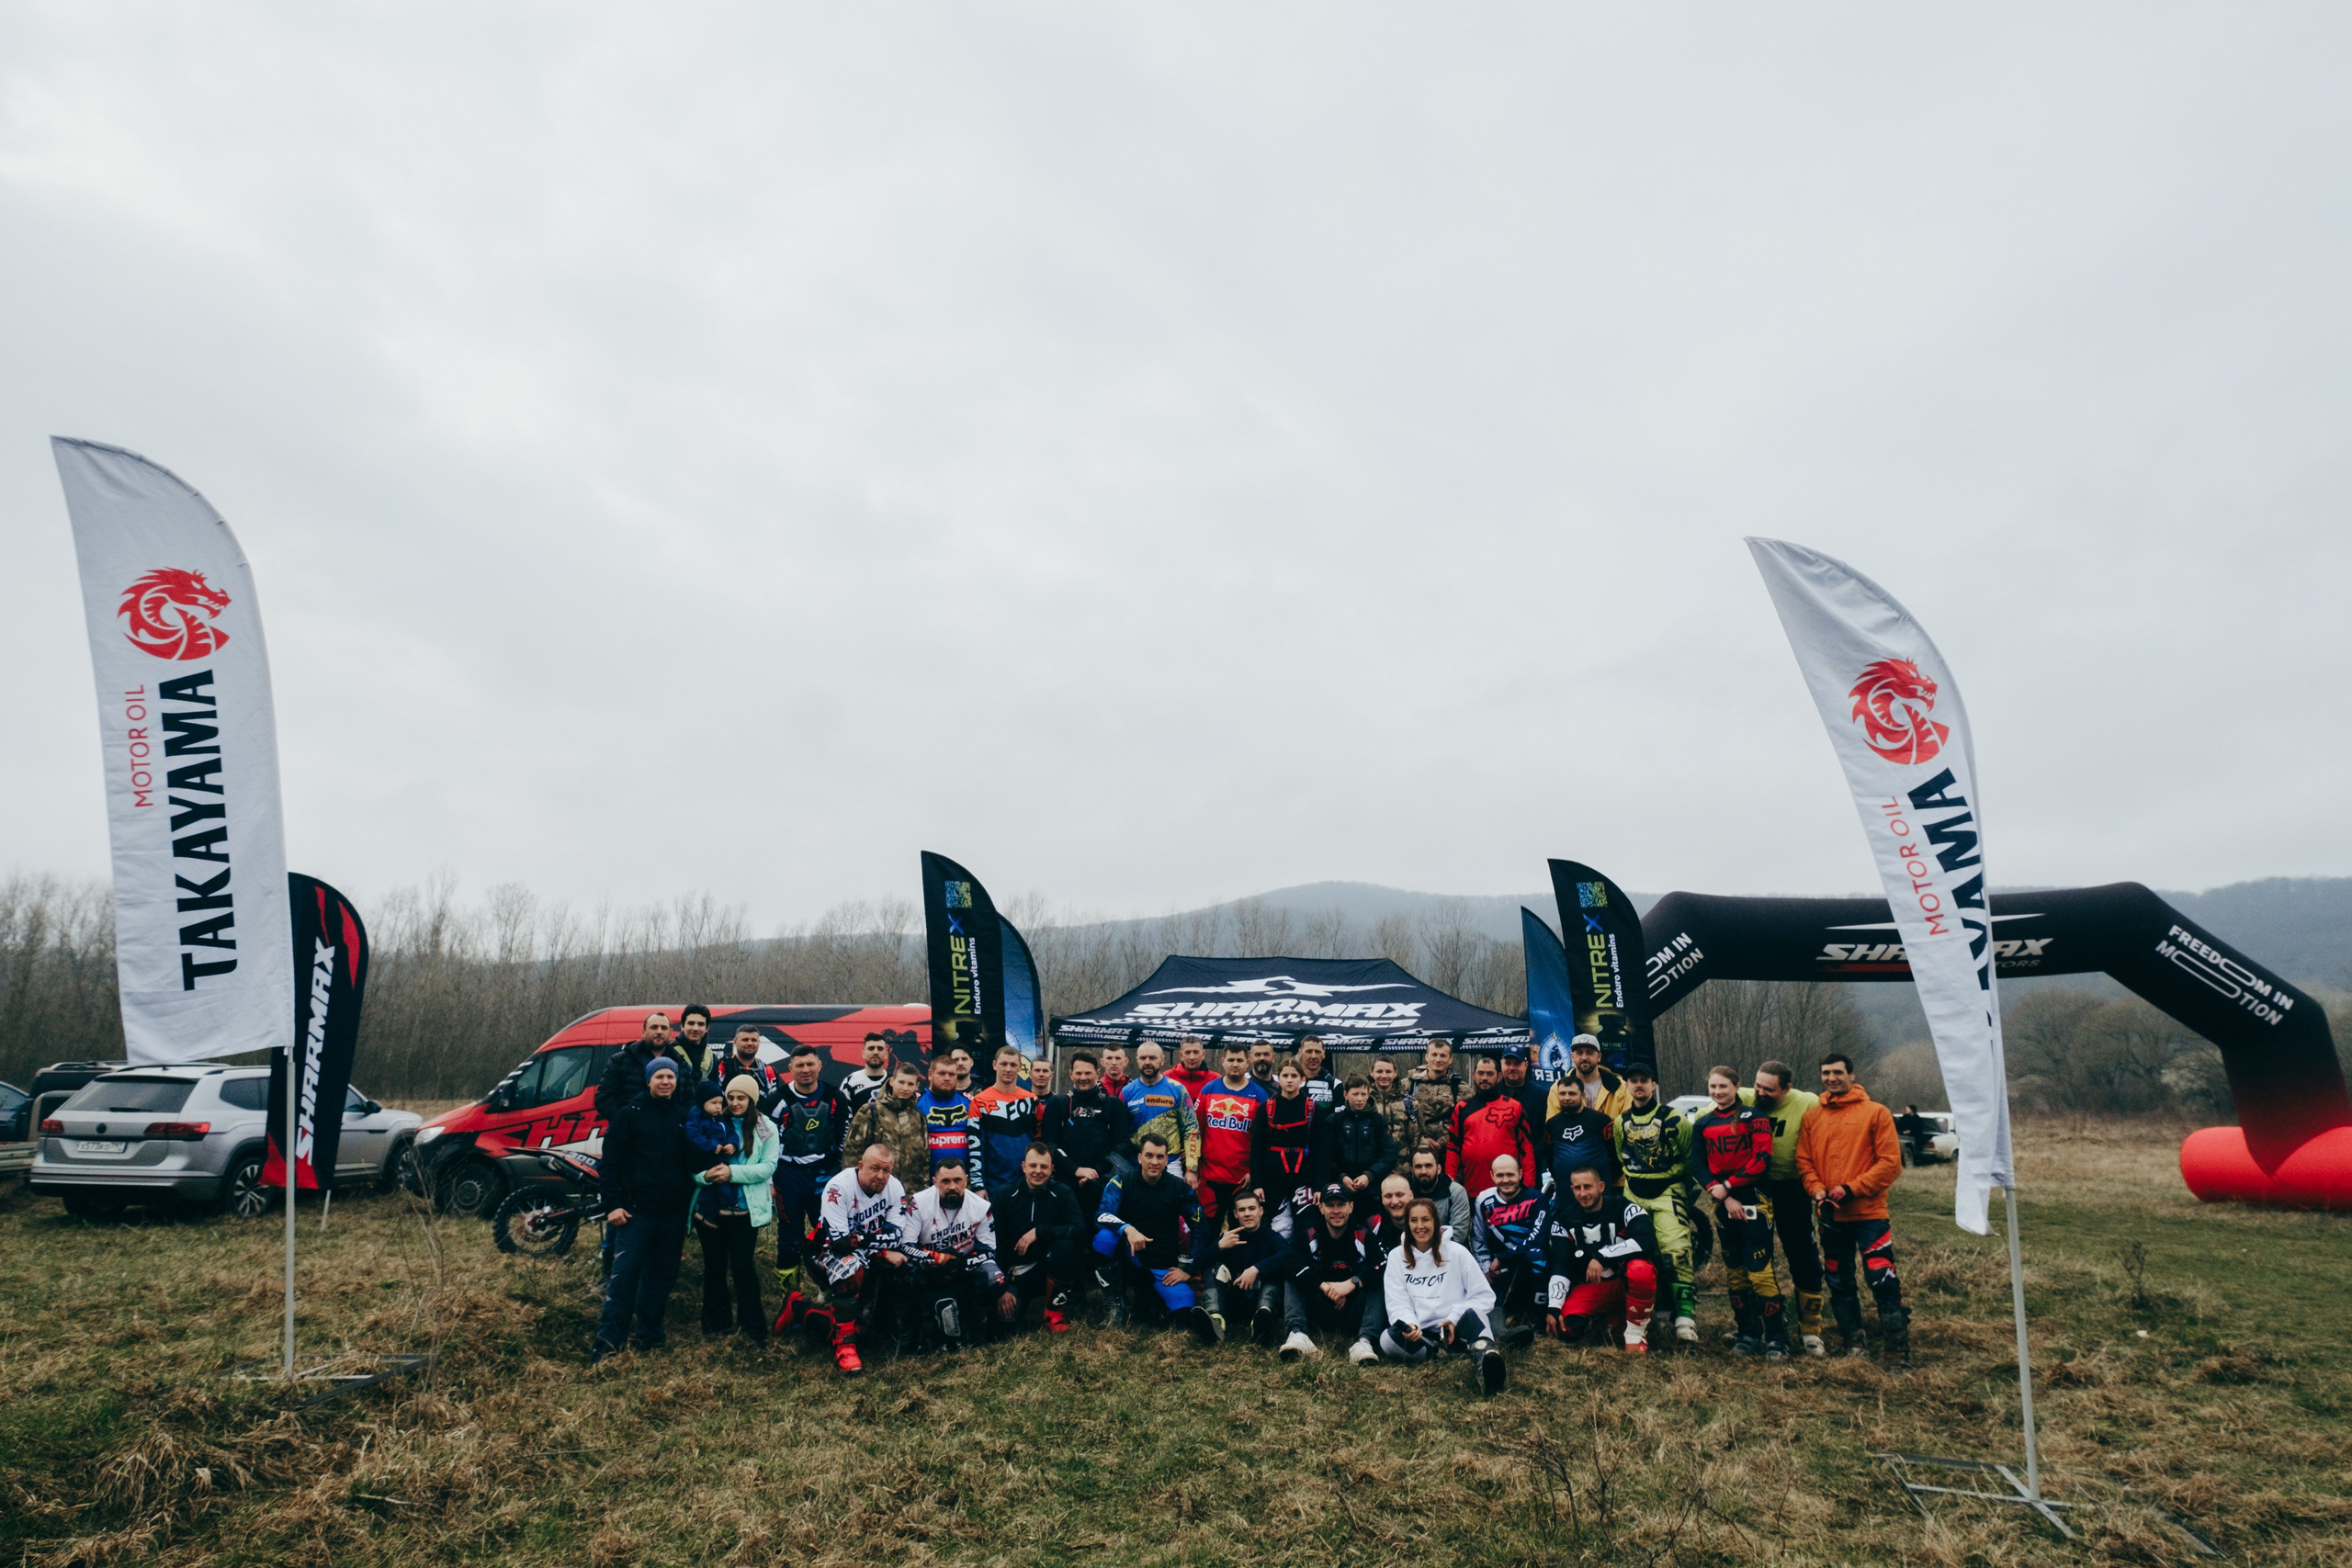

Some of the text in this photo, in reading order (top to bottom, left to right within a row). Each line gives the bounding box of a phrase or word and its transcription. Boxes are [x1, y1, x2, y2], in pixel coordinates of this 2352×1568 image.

[125, 684, 153, 807] MOTOR OIL
[158, 669, 238, 991] TAKAYAMA
[1882, 796, 1949, 935] MOTOR OIL
[947, 913, 971, 1014] NITREX
[967, 937, 977, 977] vitamins
[1583, 913, 1612, 1008] NITREX
[1608, 933, 1623, 1009] Enduro vitamins
[1671, 931, 1692, 953] IN
[2168, 924, 2294, 1010] FREEDOM IN
[1125, 998, 1427, 1018] SHARMAX
[2154, 940, 2283, 1026] MOTION
[295, 936, 335, 1166] SHARMAX
[1058, 1024, 1133, 1035] SHARMAX
[1314, 1018, 1419, 1028] RACE
[1146, 1097, 1174, 1105] enduro
[1207, 1113, 1250, 1133] Red Bull
[566, 1151, 597, 1167] 300
[1428, 1271, 1448, 1287] CAT
